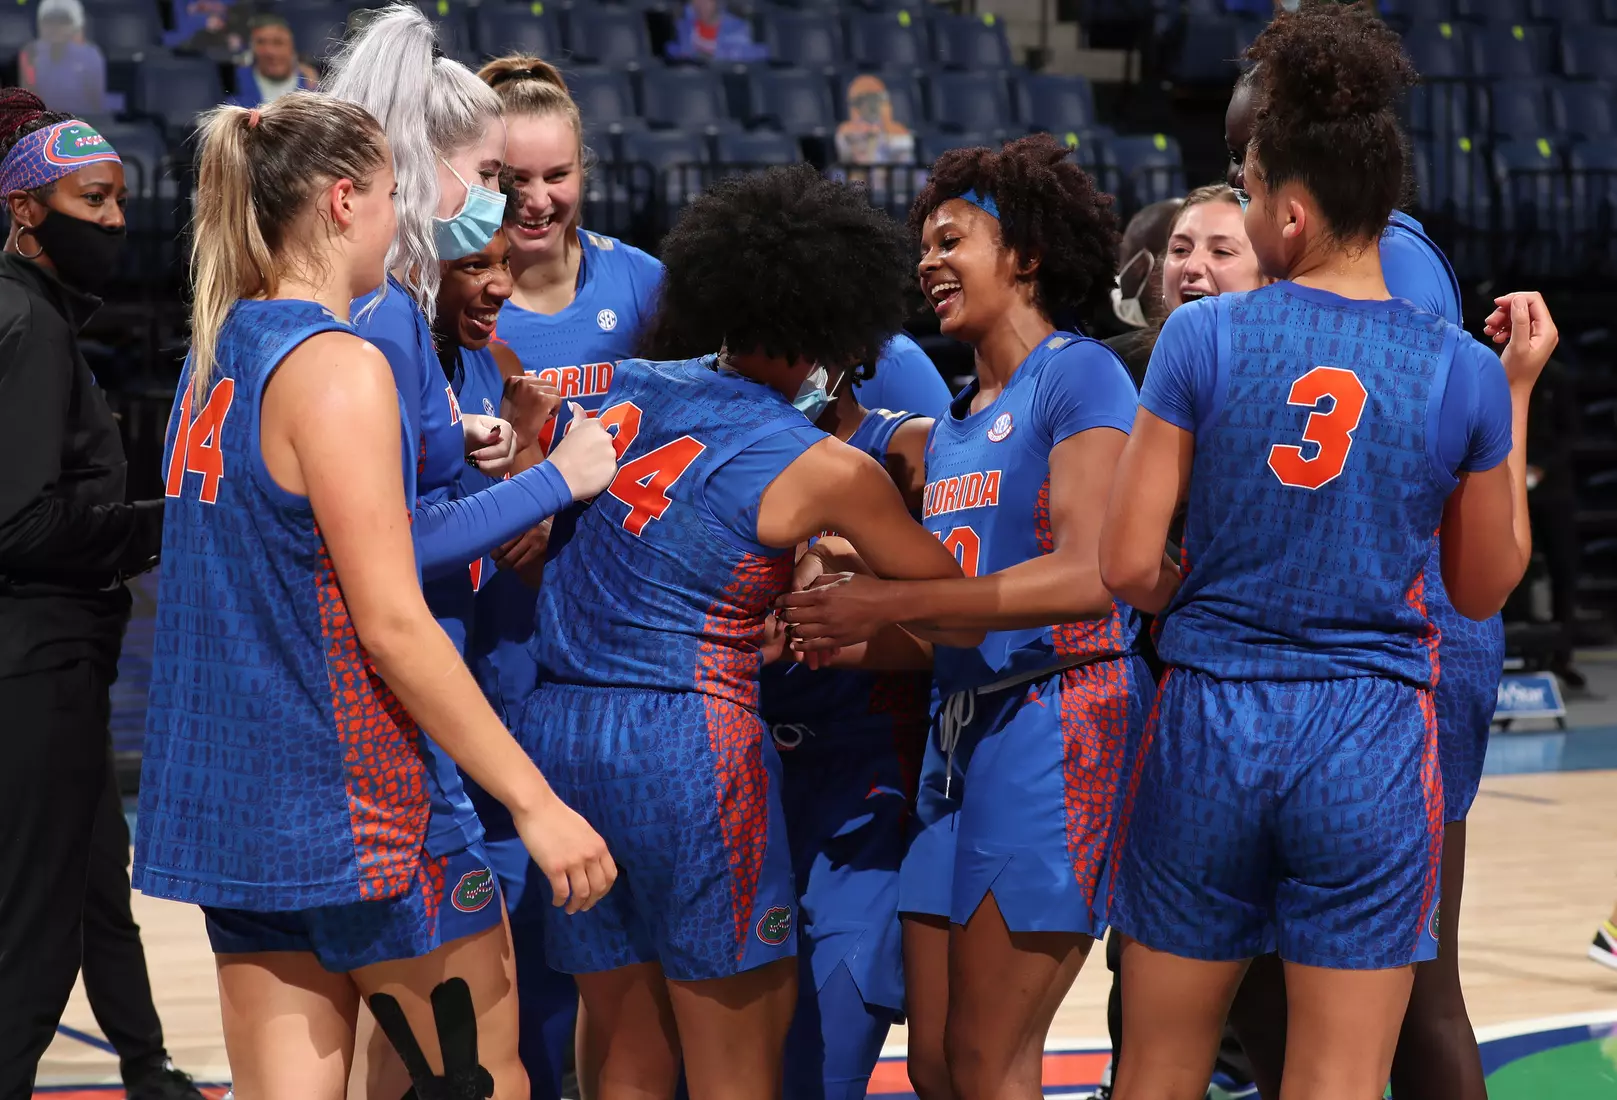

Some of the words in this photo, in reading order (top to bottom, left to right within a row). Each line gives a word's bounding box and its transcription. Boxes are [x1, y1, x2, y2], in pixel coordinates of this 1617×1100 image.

[598, 310, 616, 330] SEC
[524, 360, 622, 399] ORID
[165, 371, 235, 505] 14
[1267, 366, 1368, 490] 3
